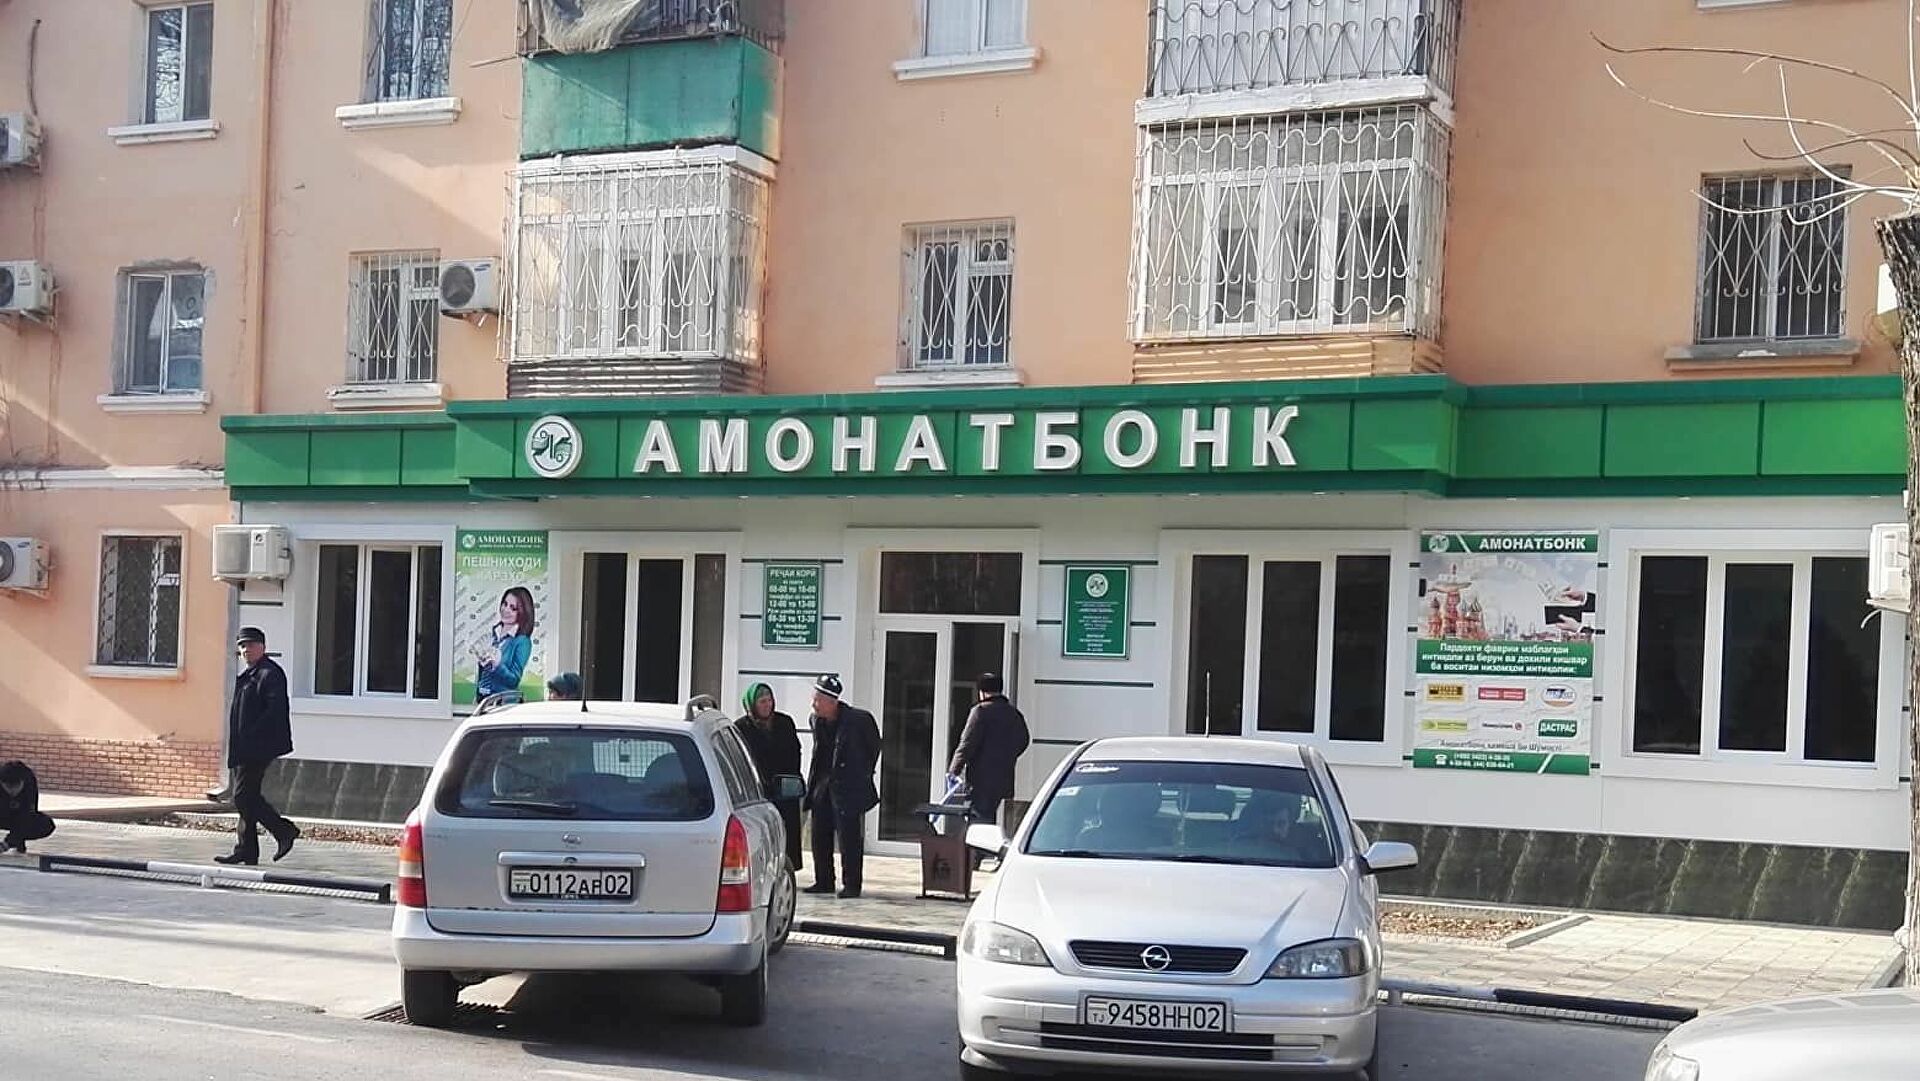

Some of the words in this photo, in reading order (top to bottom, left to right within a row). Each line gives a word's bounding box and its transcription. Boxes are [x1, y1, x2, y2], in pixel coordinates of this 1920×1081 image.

[633, 404, 1299, 474] АМОНАТБОНК
[478, 535, 543, 544] АМОНАТБОНК
[1480, 537, 1586, 550] АМОНАТБОНК
[1540, 722, 1576, 733] ДАСТРАС
[1108, 1002, 1220, 1029] 9458HH02
